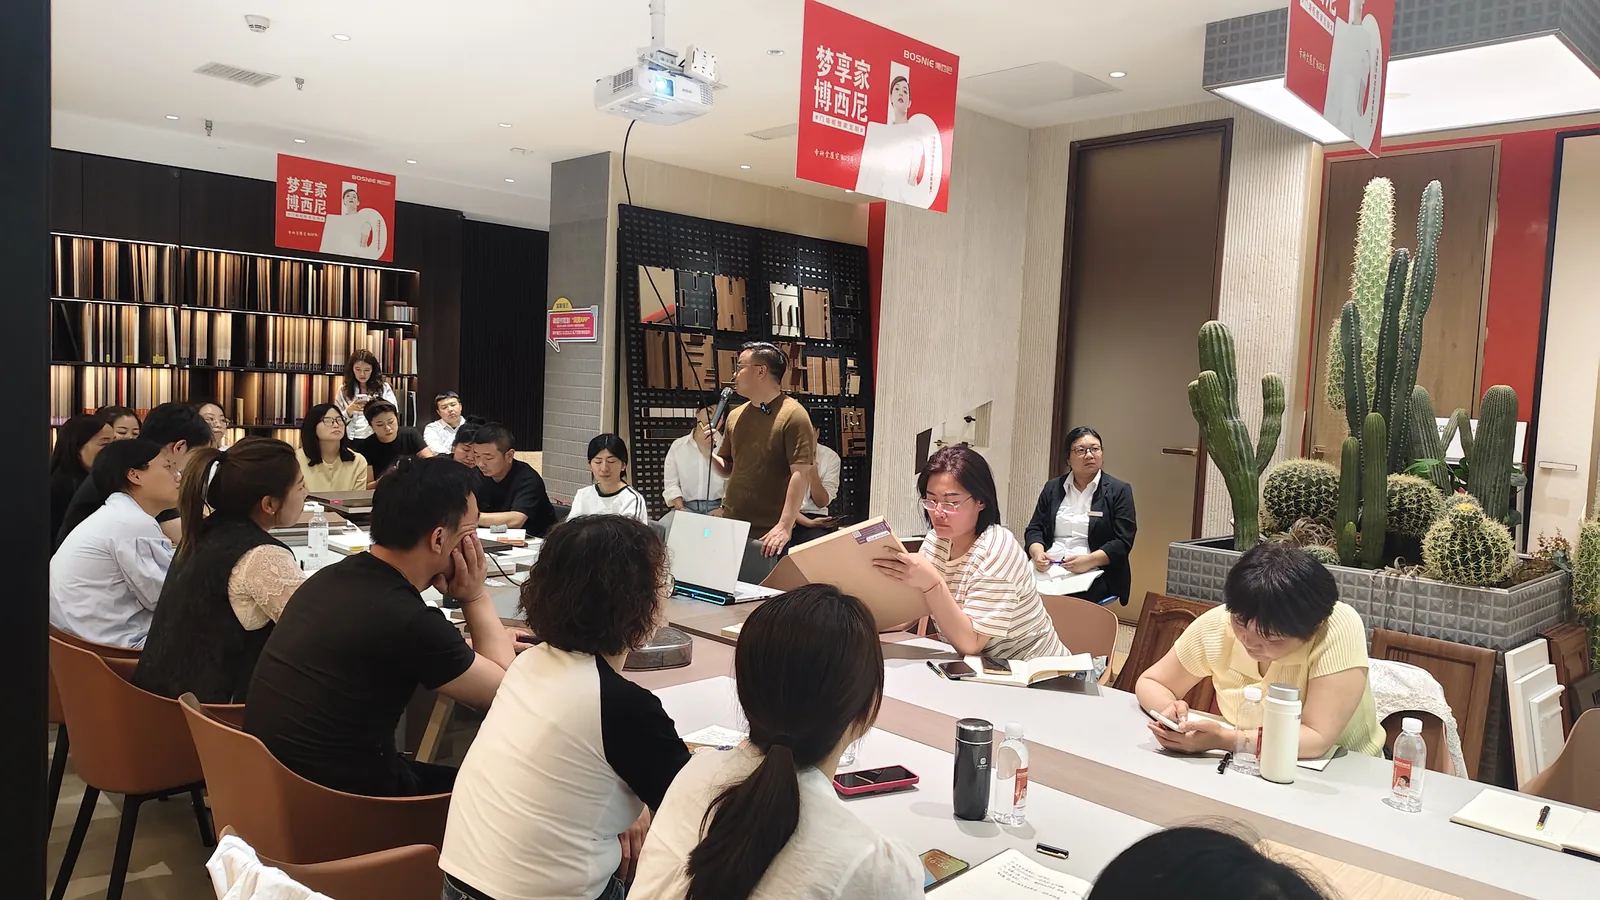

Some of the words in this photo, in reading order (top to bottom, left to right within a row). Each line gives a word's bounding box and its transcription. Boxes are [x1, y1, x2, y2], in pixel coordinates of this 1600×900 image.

[816, 45, 871, 90] 梦享家
[813, 78, 868, 123] 博西尼
[286, 176, 327, 198] 梦享家
[285, 193, 327, 216] 博西尼
